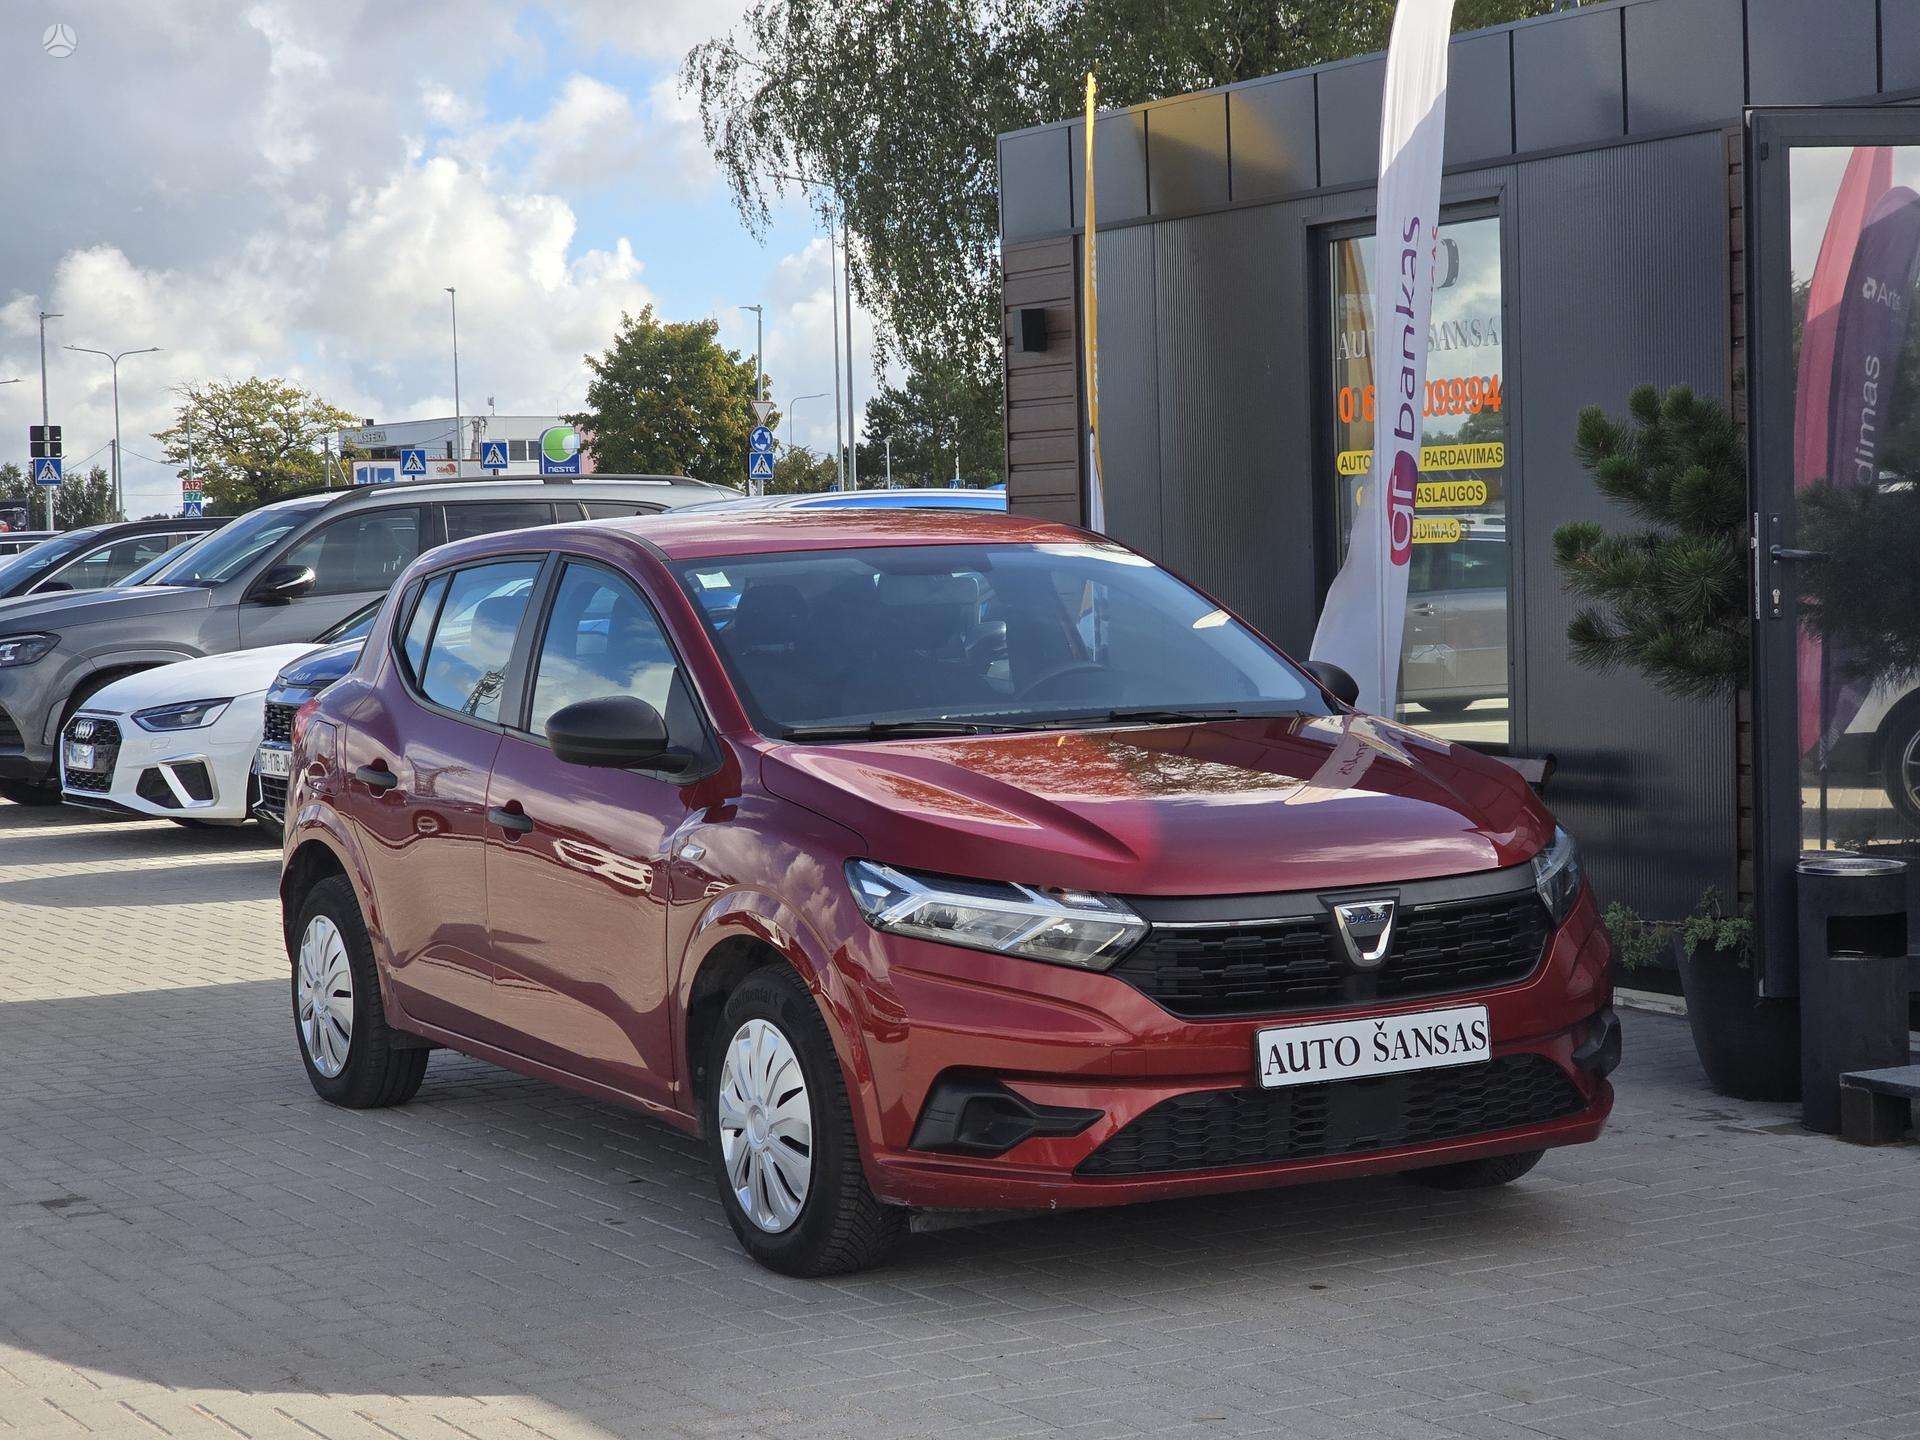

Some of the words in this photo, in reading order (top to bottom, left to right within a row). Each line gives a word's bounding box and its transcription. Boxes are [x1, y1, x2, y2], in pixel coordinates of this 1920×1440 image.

[1394, 216, 1420, 441] bankas
[1424, 446, 1503, 467] PARDAVIMAS
[184, 480, 200, 490] A12
[1416, 485, 1484, 504] ASLAUGOS
[184, 492, 201, 501] E77
[1348, 911, 1388, 925] DACIA
[1264, 1034, 1361, 1076] AUTO
[1373, 1020, 1487, 1062] ŠANSAS
